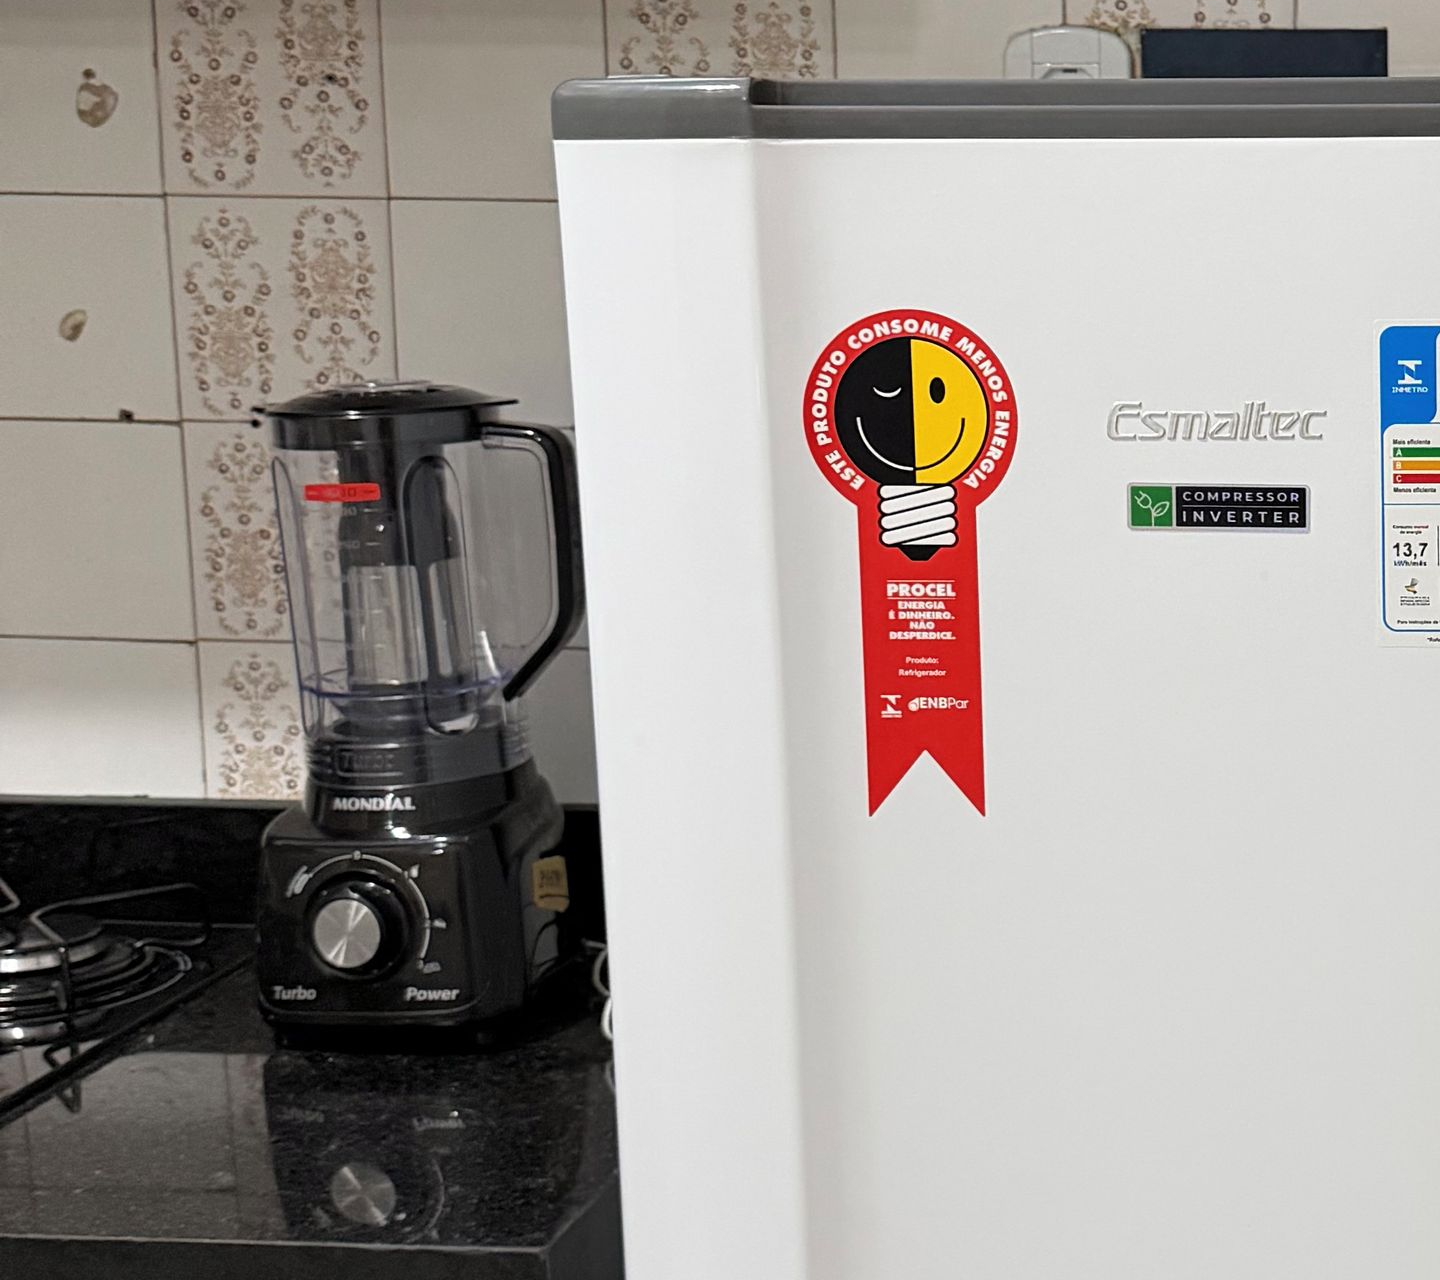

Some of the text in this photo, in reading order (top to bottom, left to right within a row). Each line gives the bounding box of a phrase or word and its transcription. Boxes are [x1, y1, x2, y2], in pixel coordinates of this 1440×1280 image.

[1391, 386, 1429, 394] INMETRO
[812, 318, 1010, 490] ESTE PRODUTO CONSOME MENOS ENERGIA
[1106, 400, 1328, 441] Esmaltec
[1395, 449, 1403, 457] A
[1395, 461, 1402, 469] B
[1395, 474, 1402, 482] C
[1182, 491, 1300, 503] COMPRESSOR
[1182, 510, 1300, 524] INVERTER
[1392, 542, 1429, 560] 13,7
[886, 583, 956, 597] PROCEL
[897, 601, 946, 610] ENERGIA
[898, 611, 956, 620] DINHEIRO.
[909, 619, 935, 630] NÃO
[889, 631, 957, 640] DESPERDICE.
[905, 656, 939, 664] Produto:
[898, 669, 947, 678] Refrigerador
[919, 696, 969, 709] ENBPar
[332, 796, 417, 811] MONDIAL
[272, 985, 317, 1001] Turbo
[404, 986, 460, 1001] Power
